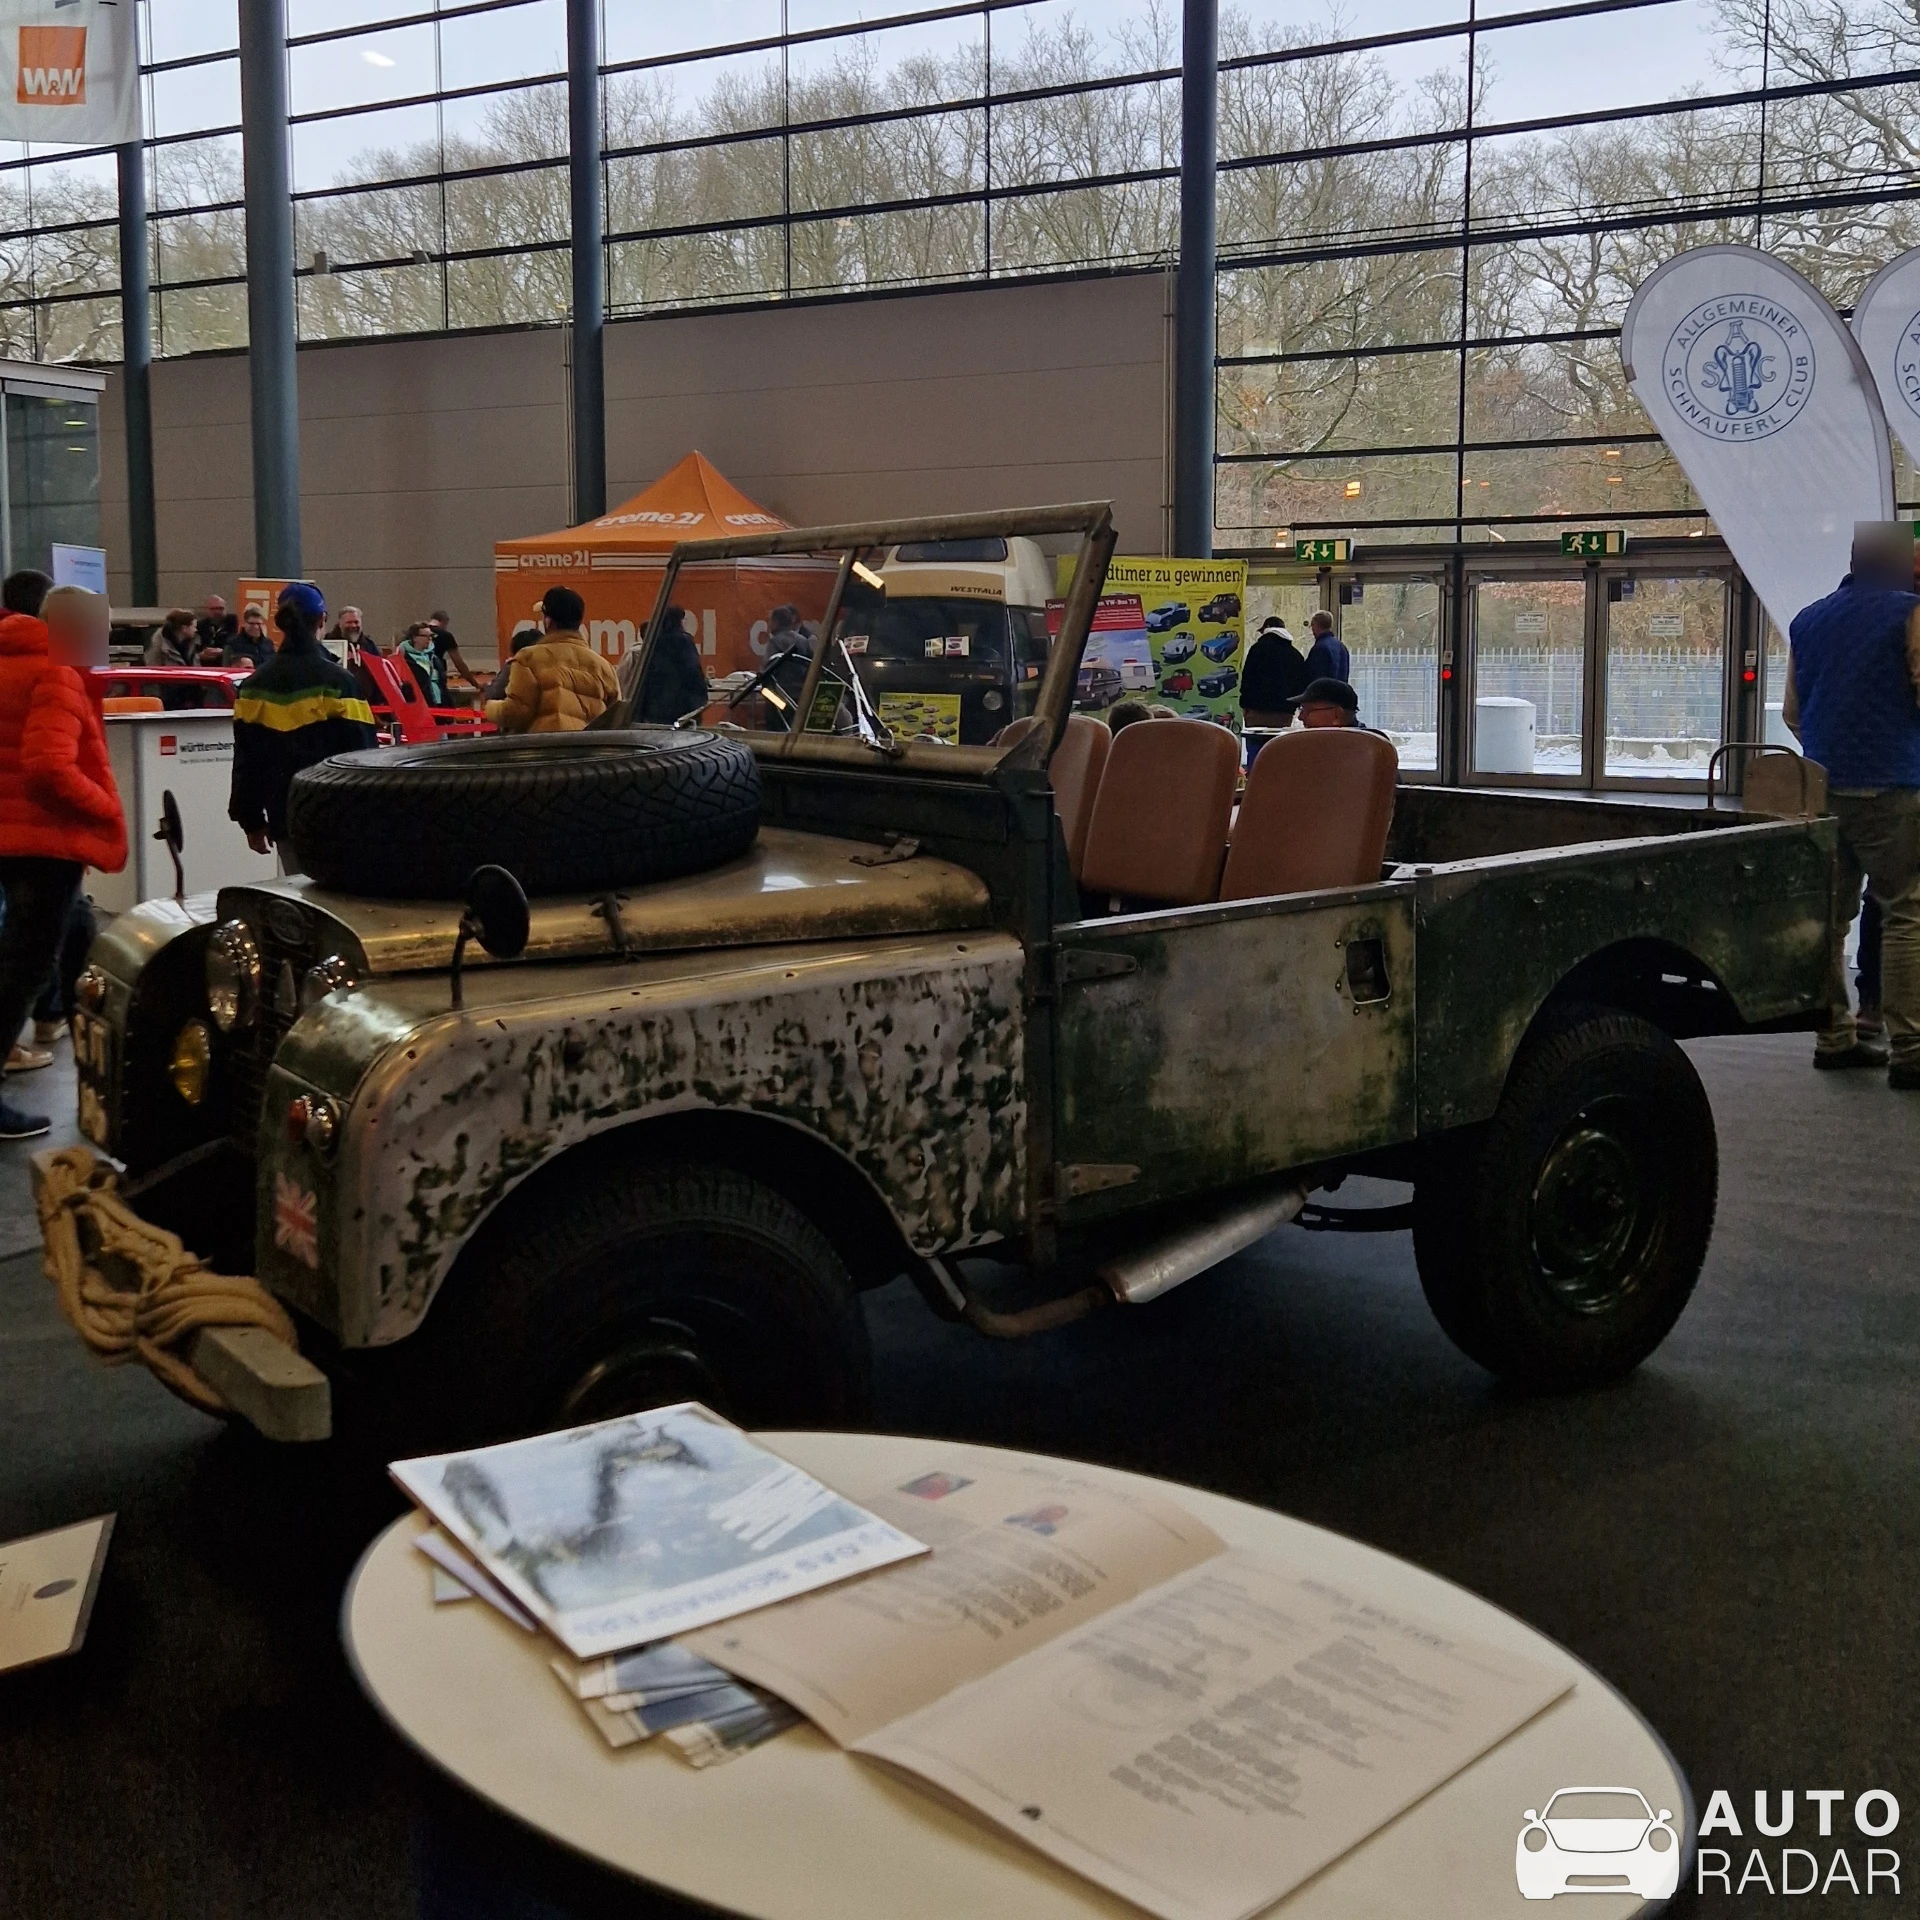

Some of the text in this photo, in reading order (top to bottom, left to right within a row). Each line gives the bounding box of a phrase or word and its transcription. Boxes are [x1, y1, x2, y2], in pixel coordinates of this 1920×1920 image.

[23, 67, 82, 96] W&W
[1677, 300, 1798, 349] ALLGEMEINER
[1786, 356, 1808, 408] CLUB
[1670, 367, 1781, 435] SCHNAUFERL
[1106, 563, 1244, 586] dtimer zu gewinnen!
[950, 585, 1002, 595] WESTFALIA
[180, 741, 234, 752] württember
